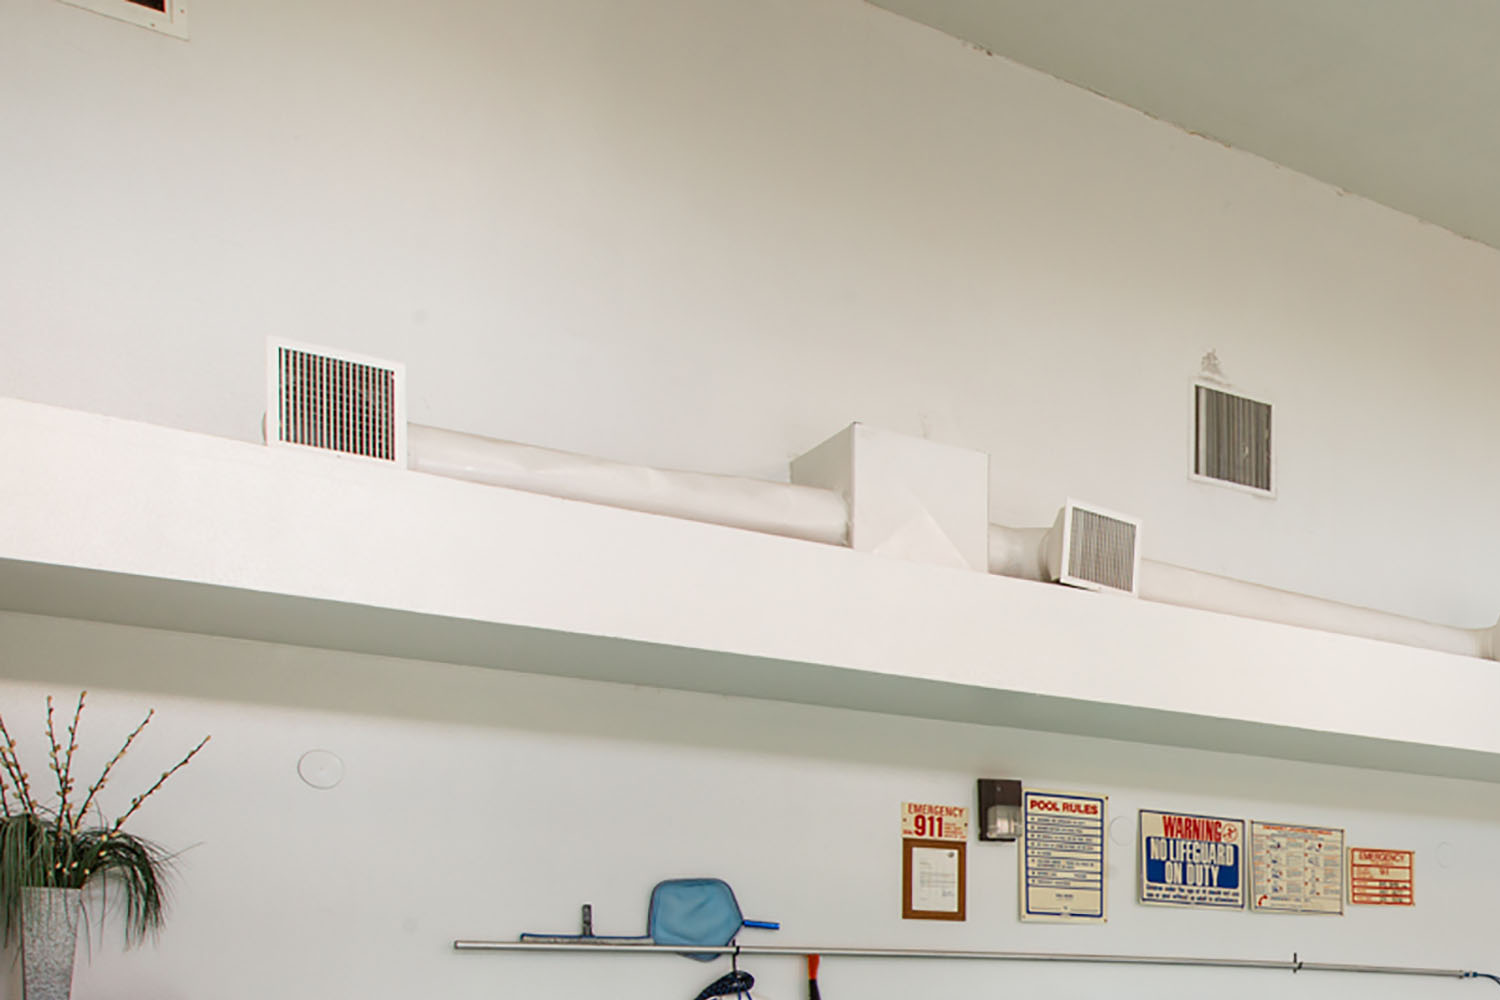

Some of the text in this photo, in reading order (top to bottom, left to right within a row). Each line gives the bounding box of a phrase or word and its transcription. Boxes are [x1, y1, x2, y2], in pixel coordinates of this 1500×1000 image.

[908, 802, 964, 817] EMERGENCY
[1030, 799, 1099, 815] POOL RULES
[914, 814, 943, 837] 911
[1162, 815, 1222, 842] WARNING
[1150, 837, 1168, 860] NO
[1169, 839, 1234, 866] LIFEGUARD
[1358, 851, 1404, 863] EMERGENCY
[1165, 860, 1219, 887] ON DUTY
